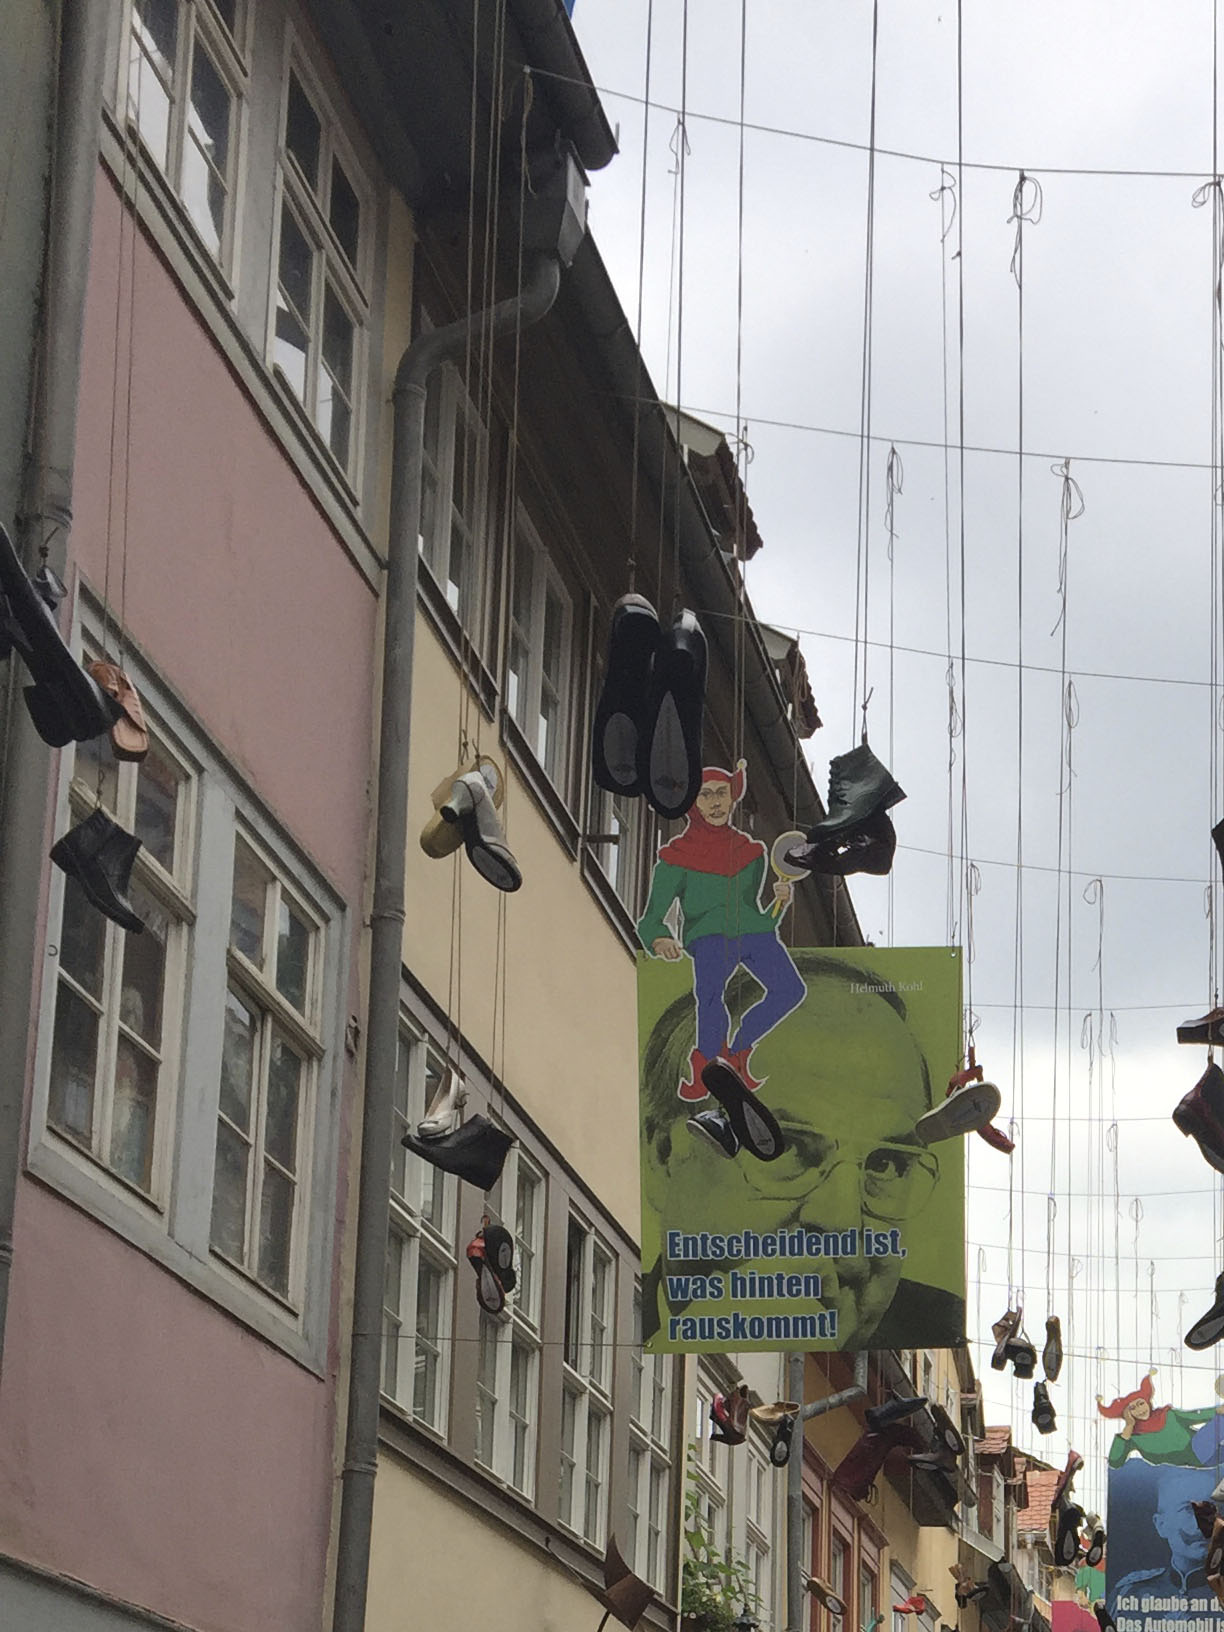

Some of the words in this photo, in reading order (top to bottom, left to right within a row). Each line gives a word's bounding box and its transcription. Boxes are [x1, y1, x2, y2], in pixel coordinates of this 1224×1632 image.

[850, 982, 896, 993] Helmuth
[898, 981, 924, 992] Kohl
[667, 1228, 858, 1260] Entscheidend
[863, 1228, 908, 1258] ist,
[667, 1274, 725, 1301] was
[730, 1270, 822, 1300] hinten
[667, 1309, 839, 1342] rauskommt!
[1117, 1595, 1138, 1611] Ich
[1141, 1595, 1188, 1613] glaube
[1190, 1599, 1208, 1612] an
[1117, 1617, 1142, 1632] Das
